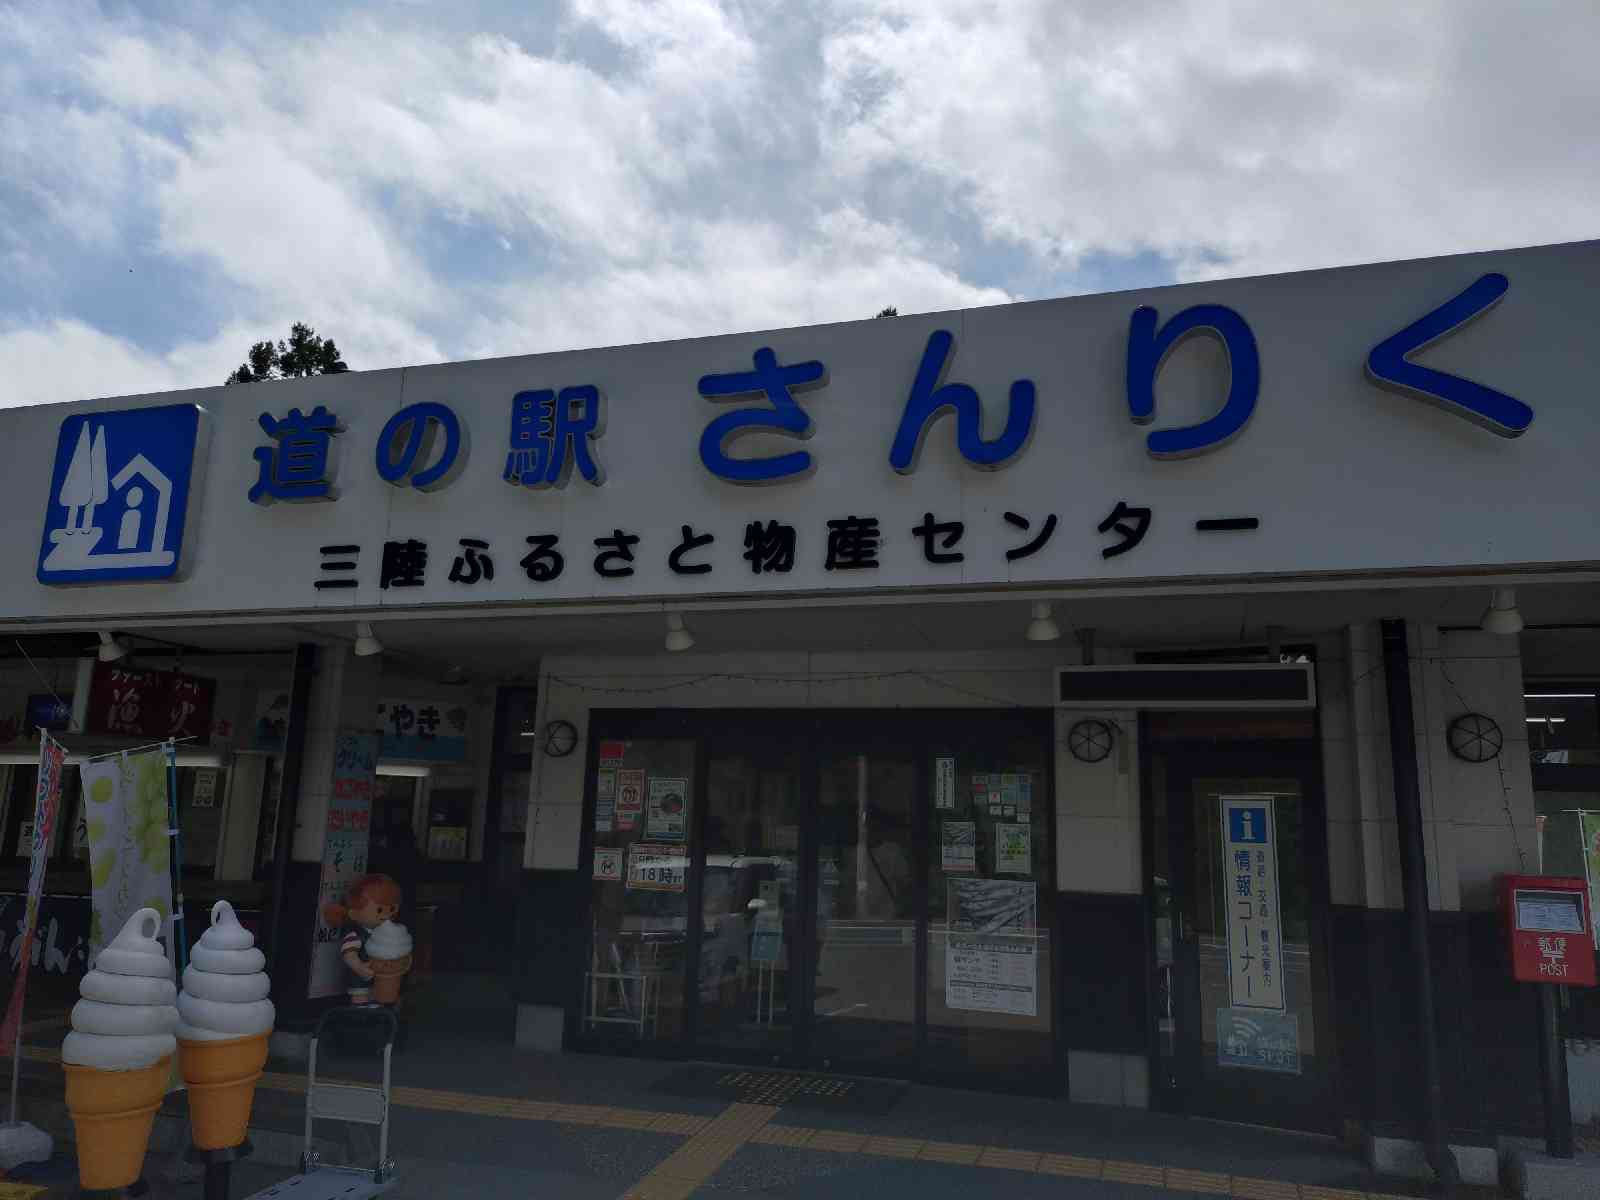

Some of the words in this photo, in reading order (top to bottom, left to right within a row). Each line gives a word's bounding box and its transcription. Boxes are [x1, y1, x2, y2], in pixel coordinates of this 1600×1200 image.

[250, 386, 604, 501] 道の駅
[700, 272, 1534, 484] さんりく
[315, 503, 1258, 588] 三陸ふるさと物産センター
[1234, 850, 1257, 1000] 情報コーナー
